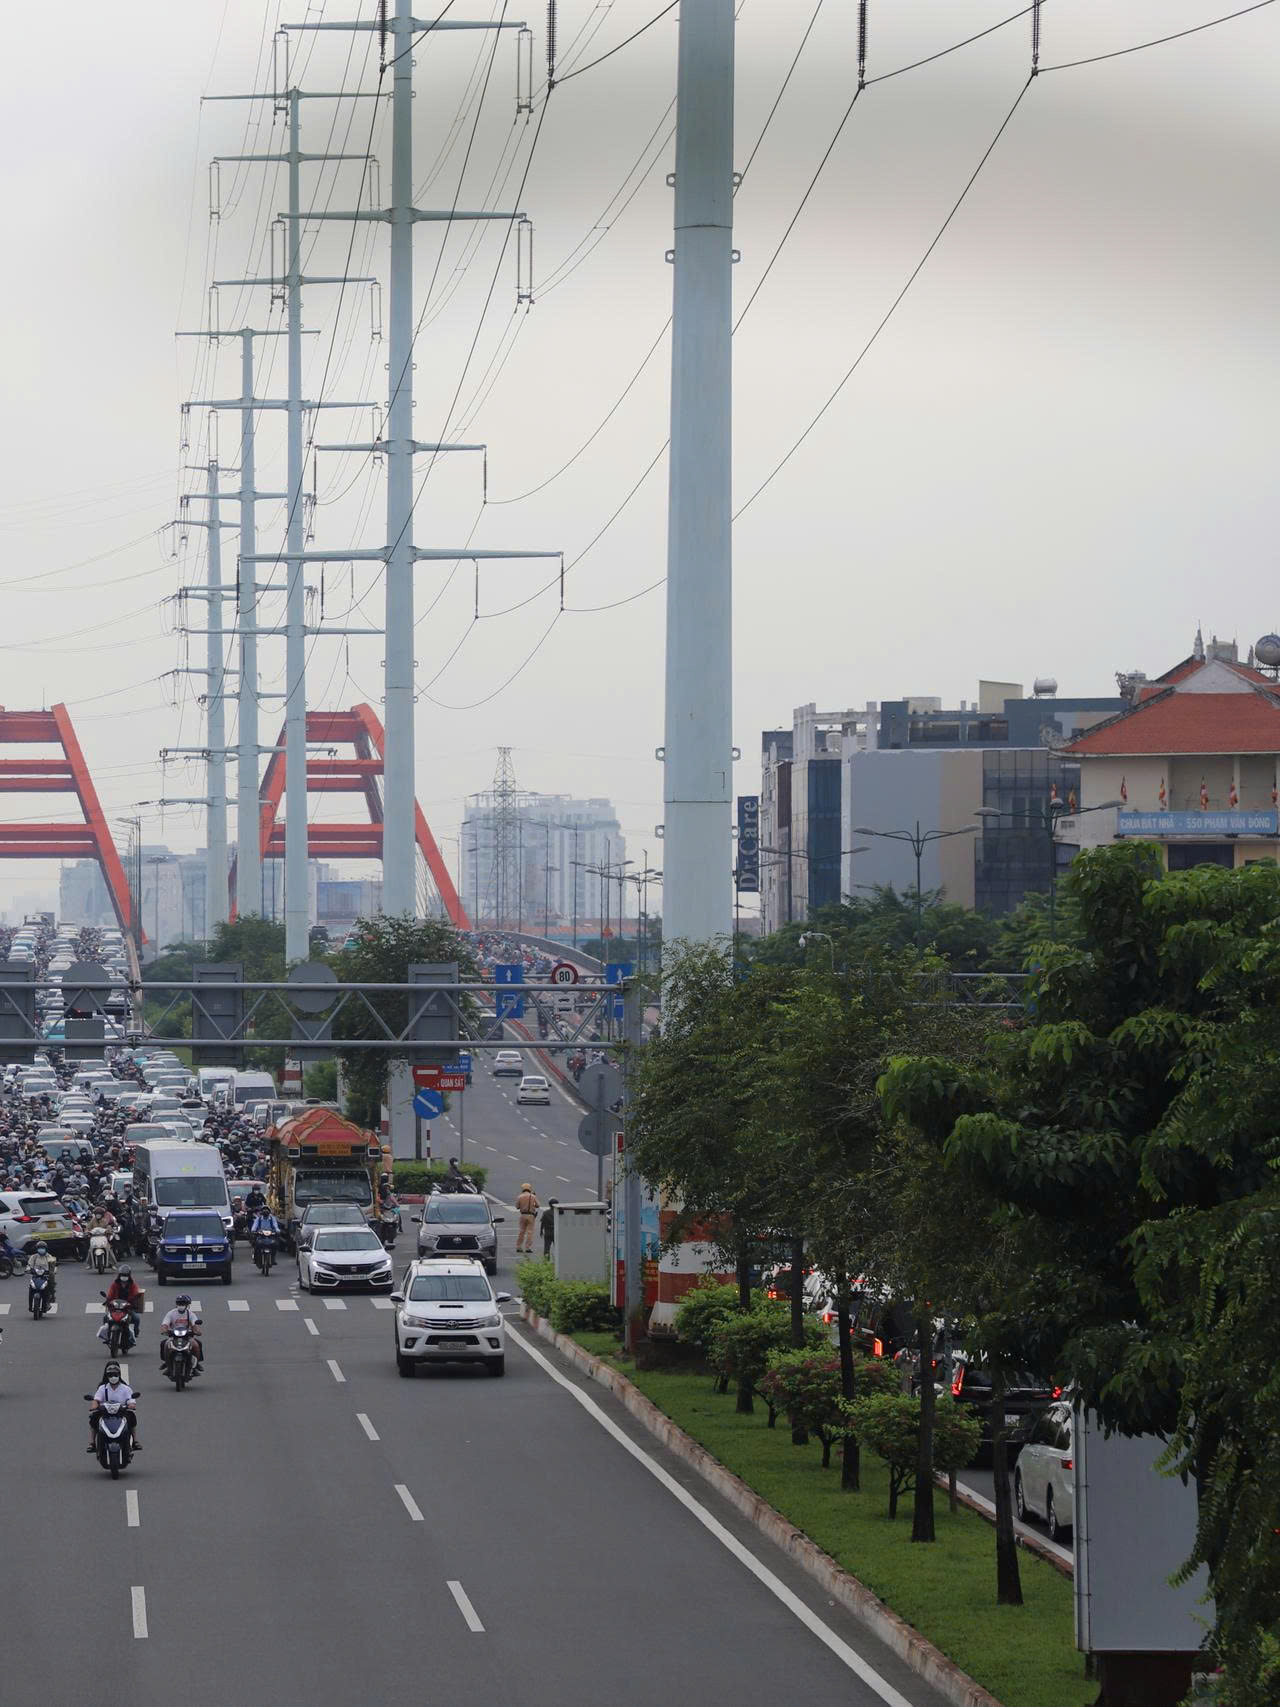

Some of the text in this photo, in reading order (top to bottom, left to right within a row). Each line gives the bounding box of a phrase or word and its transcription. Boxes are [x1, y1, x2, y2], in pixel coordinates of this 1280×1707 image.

[1186, 817, 1201, 829] 550
[559, 970, 571, 982] 80
[440, 1077, 454, 1088] QUAN
